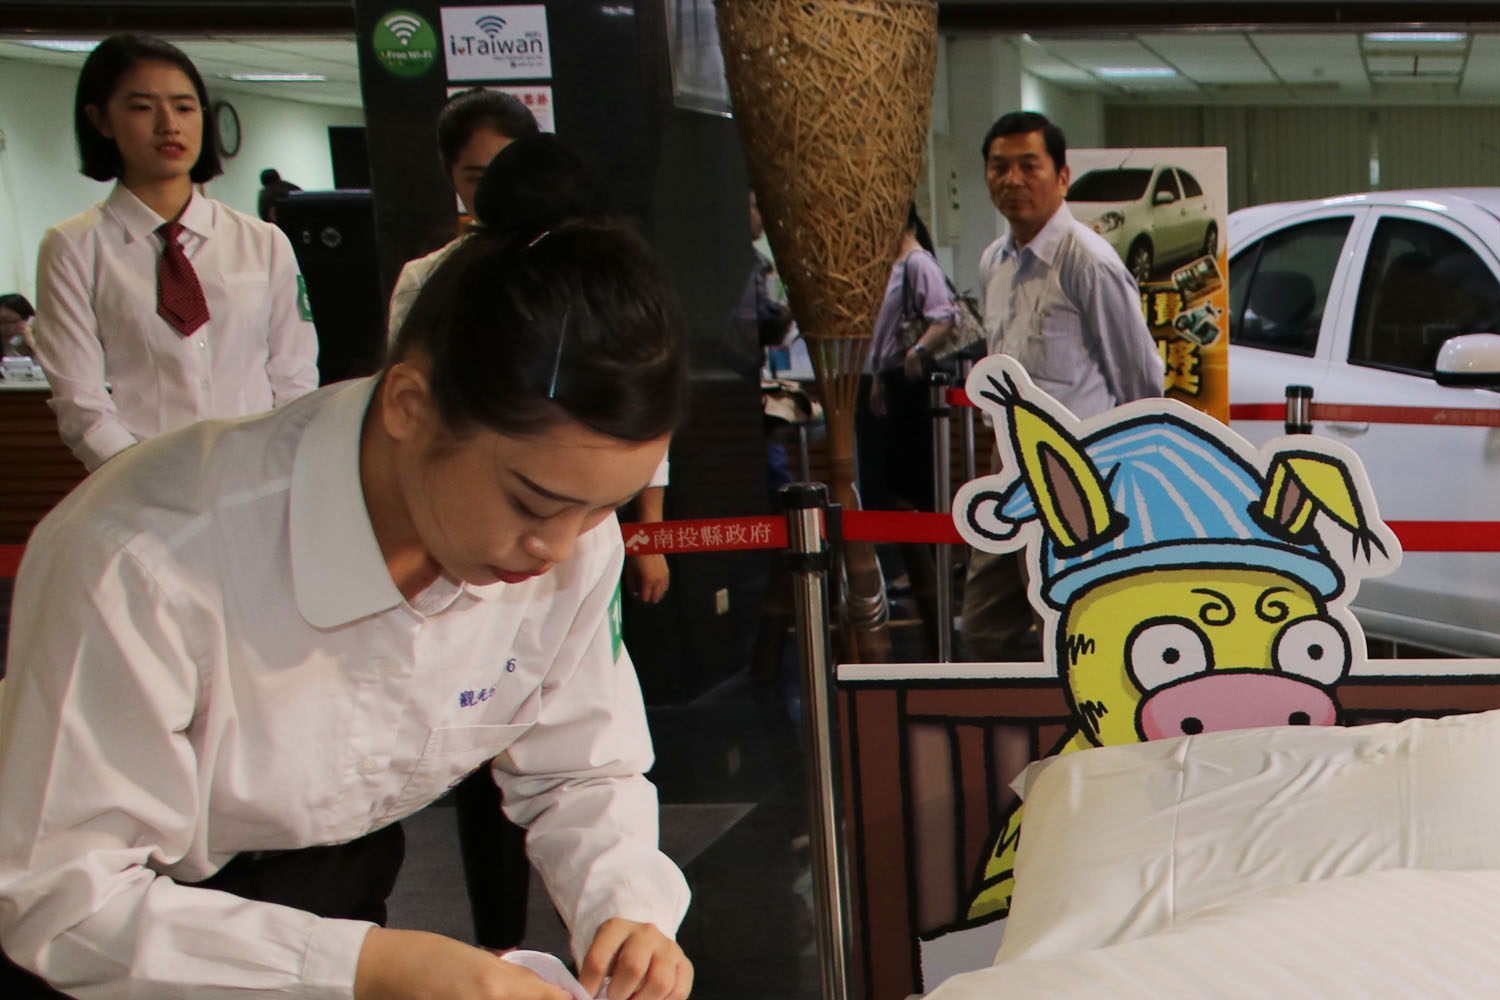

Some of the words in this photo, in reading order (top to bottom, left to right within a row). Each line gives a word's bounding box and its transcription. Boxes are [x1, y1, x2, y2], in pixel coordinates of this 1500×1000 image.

[652, 521, 772, 549] 南投縣政府
